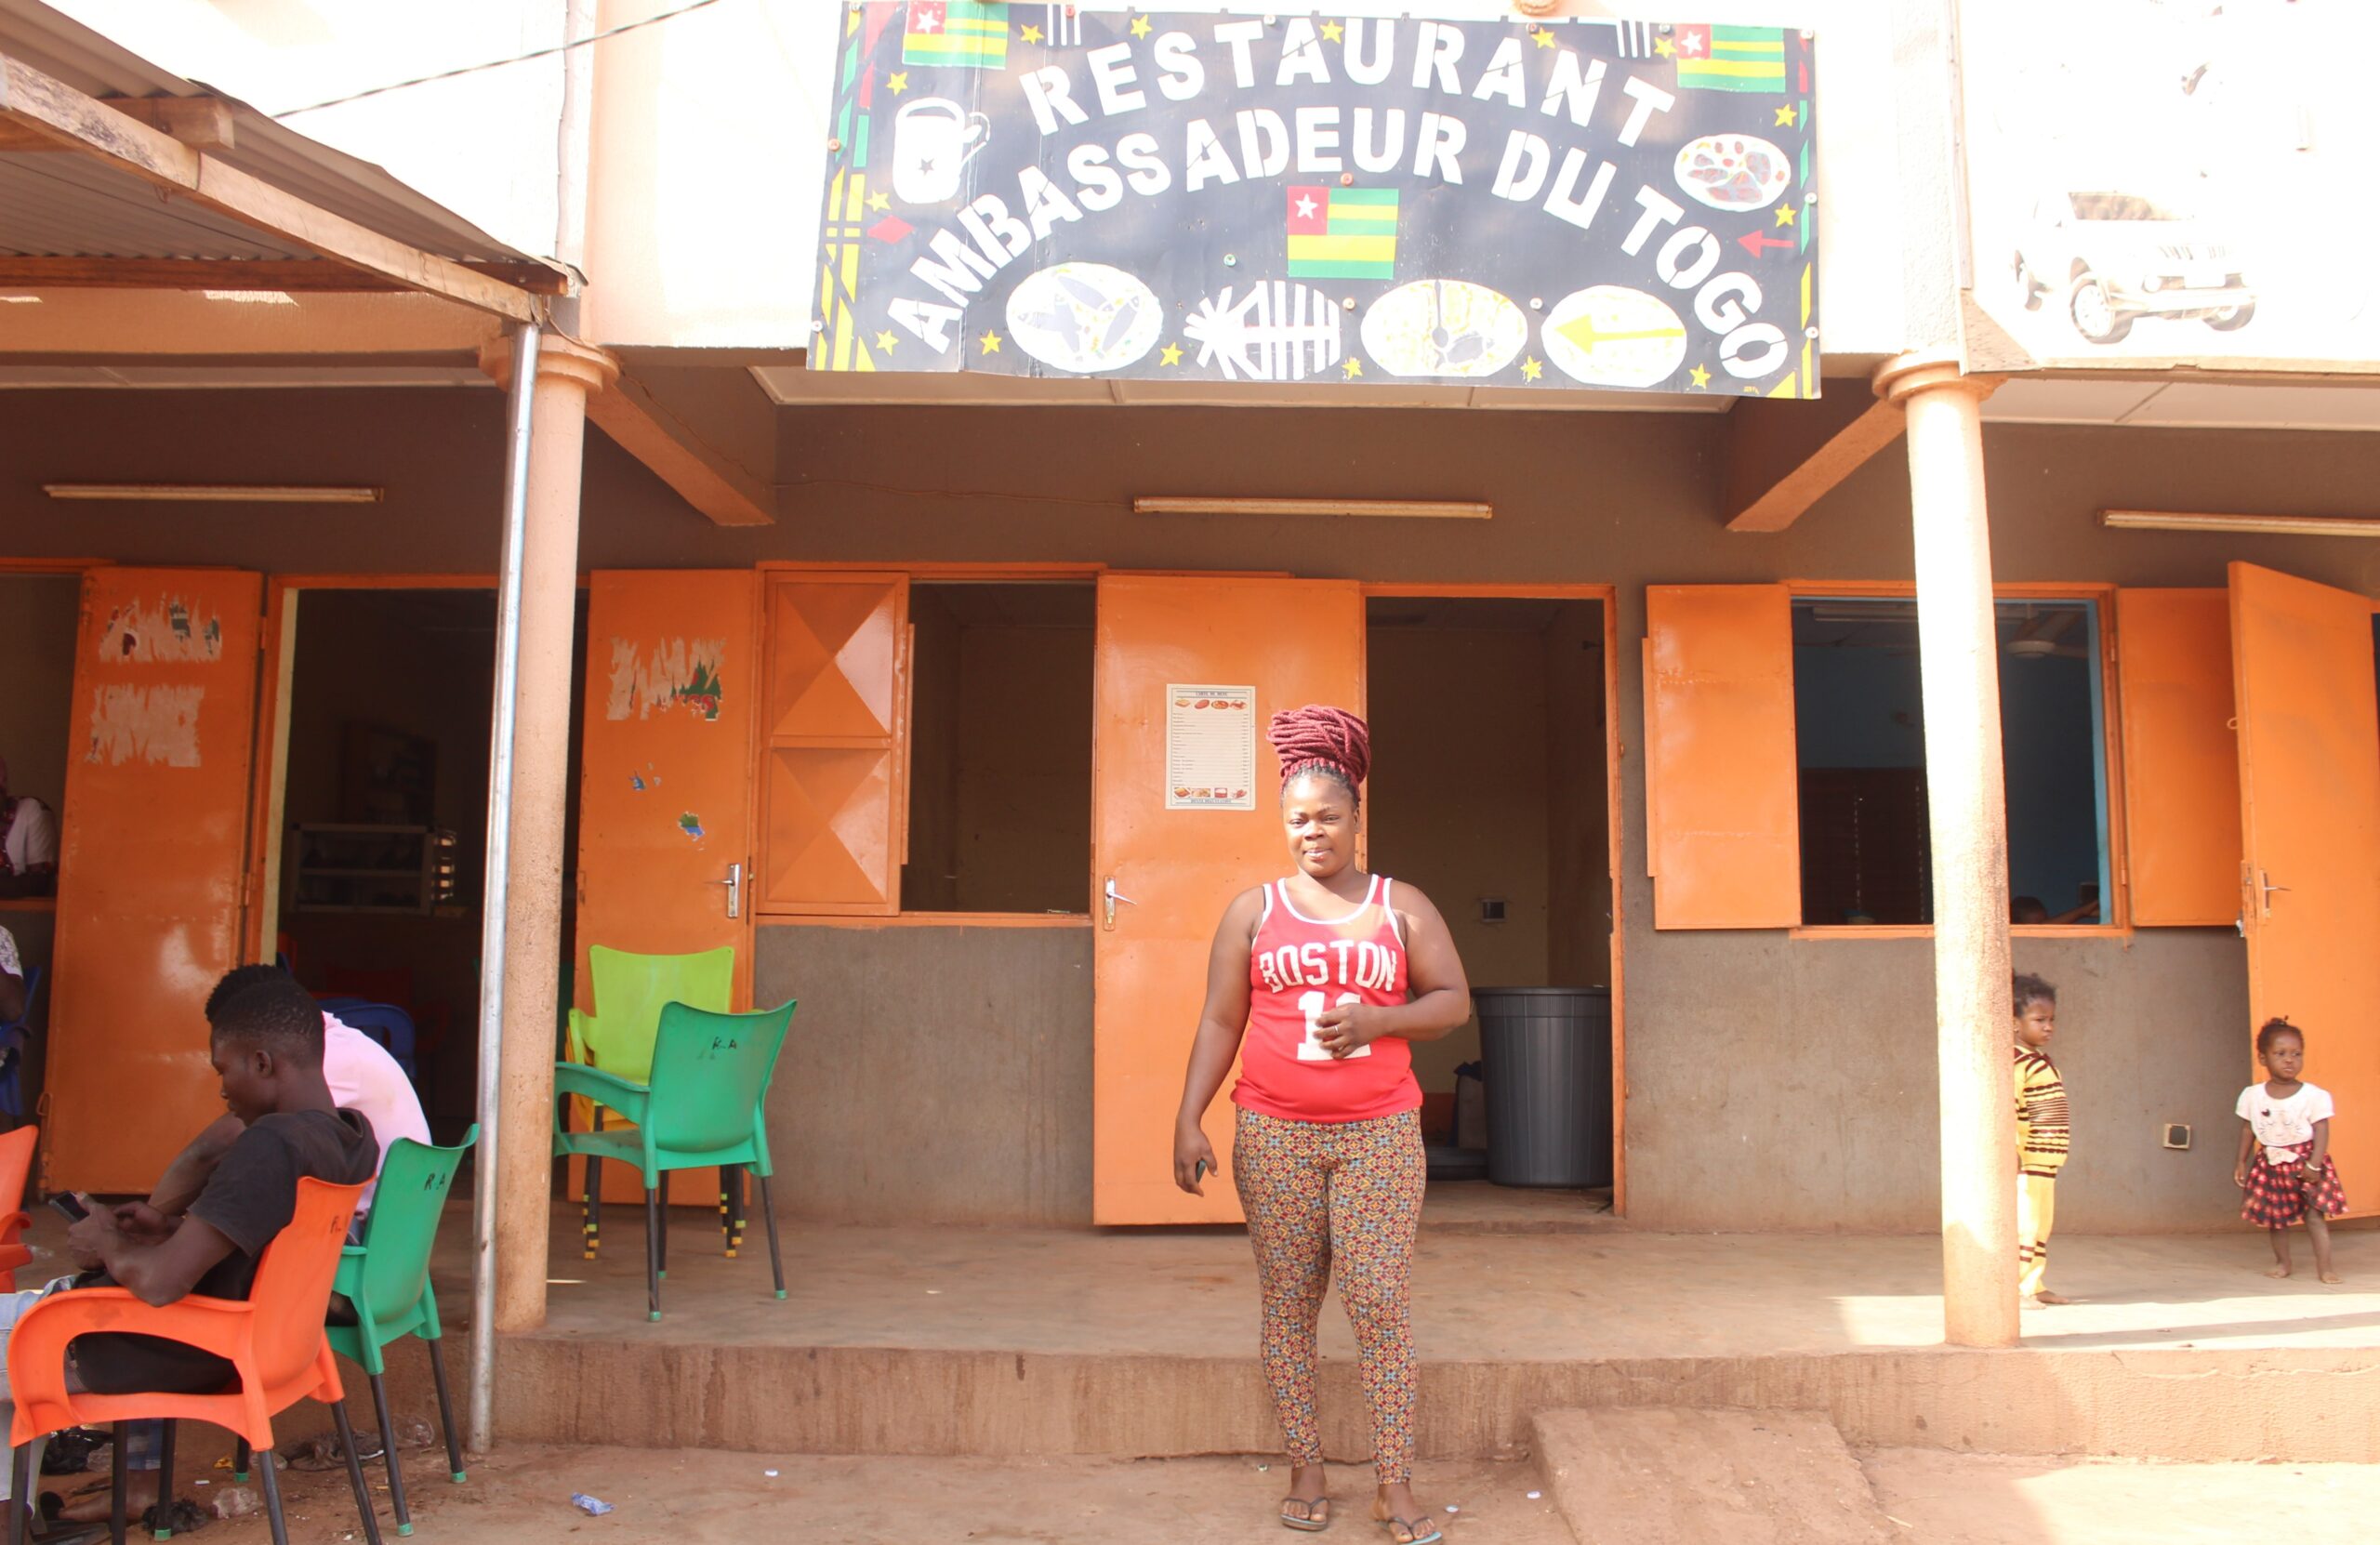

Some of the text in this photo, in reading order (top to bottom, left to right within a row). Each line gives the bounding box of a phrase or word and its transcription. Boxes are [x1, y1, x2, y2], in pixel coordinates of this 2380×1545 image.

[1019, 18, 1676, 148] RESTAURANT
[886, 107, 1789, 379] AMBASSADEUR DU TOGO
[1259, 940, 1397, 994] BOSTON
